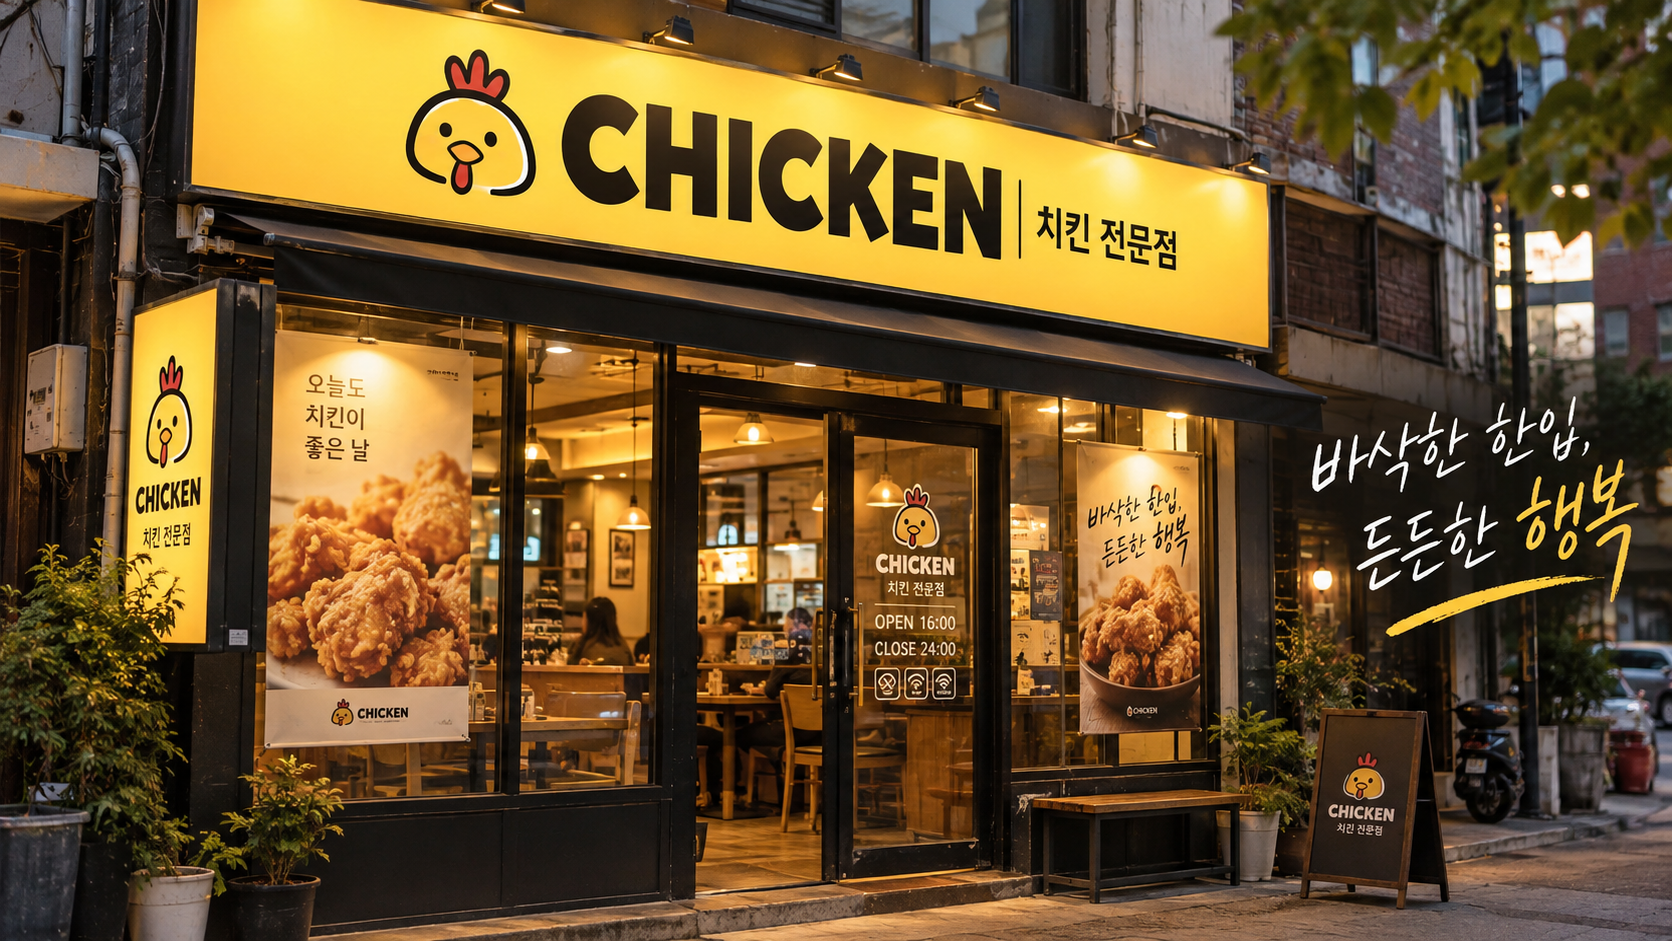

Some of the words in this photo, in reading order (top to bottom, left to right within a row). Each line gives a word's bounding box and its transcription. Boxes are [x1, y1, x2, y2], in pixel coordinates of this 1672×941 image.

[562, 94, 1002, 260] CHICKEN
[1036, 205, 1090, 255] 치킨
[1100, 218, 1177, 271] 전문점
[305, 373, 366, 399] 오늘도
[305, 404, 365, 431] 치킨이
[304, 435, 345, 461] 좋은
[351, 438, 370, 463] 날
[135, 476, 202, 515] CHICKEN
[1087, 495, 1141, 530] 바삭한
[142, 526, 160, 550] 치킨
[163, 522, 191, 548] 전문점
[1101, 532, 1147, 569] 든든한
[1152, 513, 1191, 568] 행복
[875, 553, 956, 576] CHICKEN
[887, 580, 910, 597] 치킨
[913, 581, 945, 597] 전문점
[874, 613, 914, 630] OPEN
[919, 615, 957, 631] 16:00
[874, 640, 917, 656] CLOSE
[920, 641, 957, 657] 24:00
[357, 707, 409, 719] CHICKEN
[1328, 803, 1396, 823] CHICKEN
